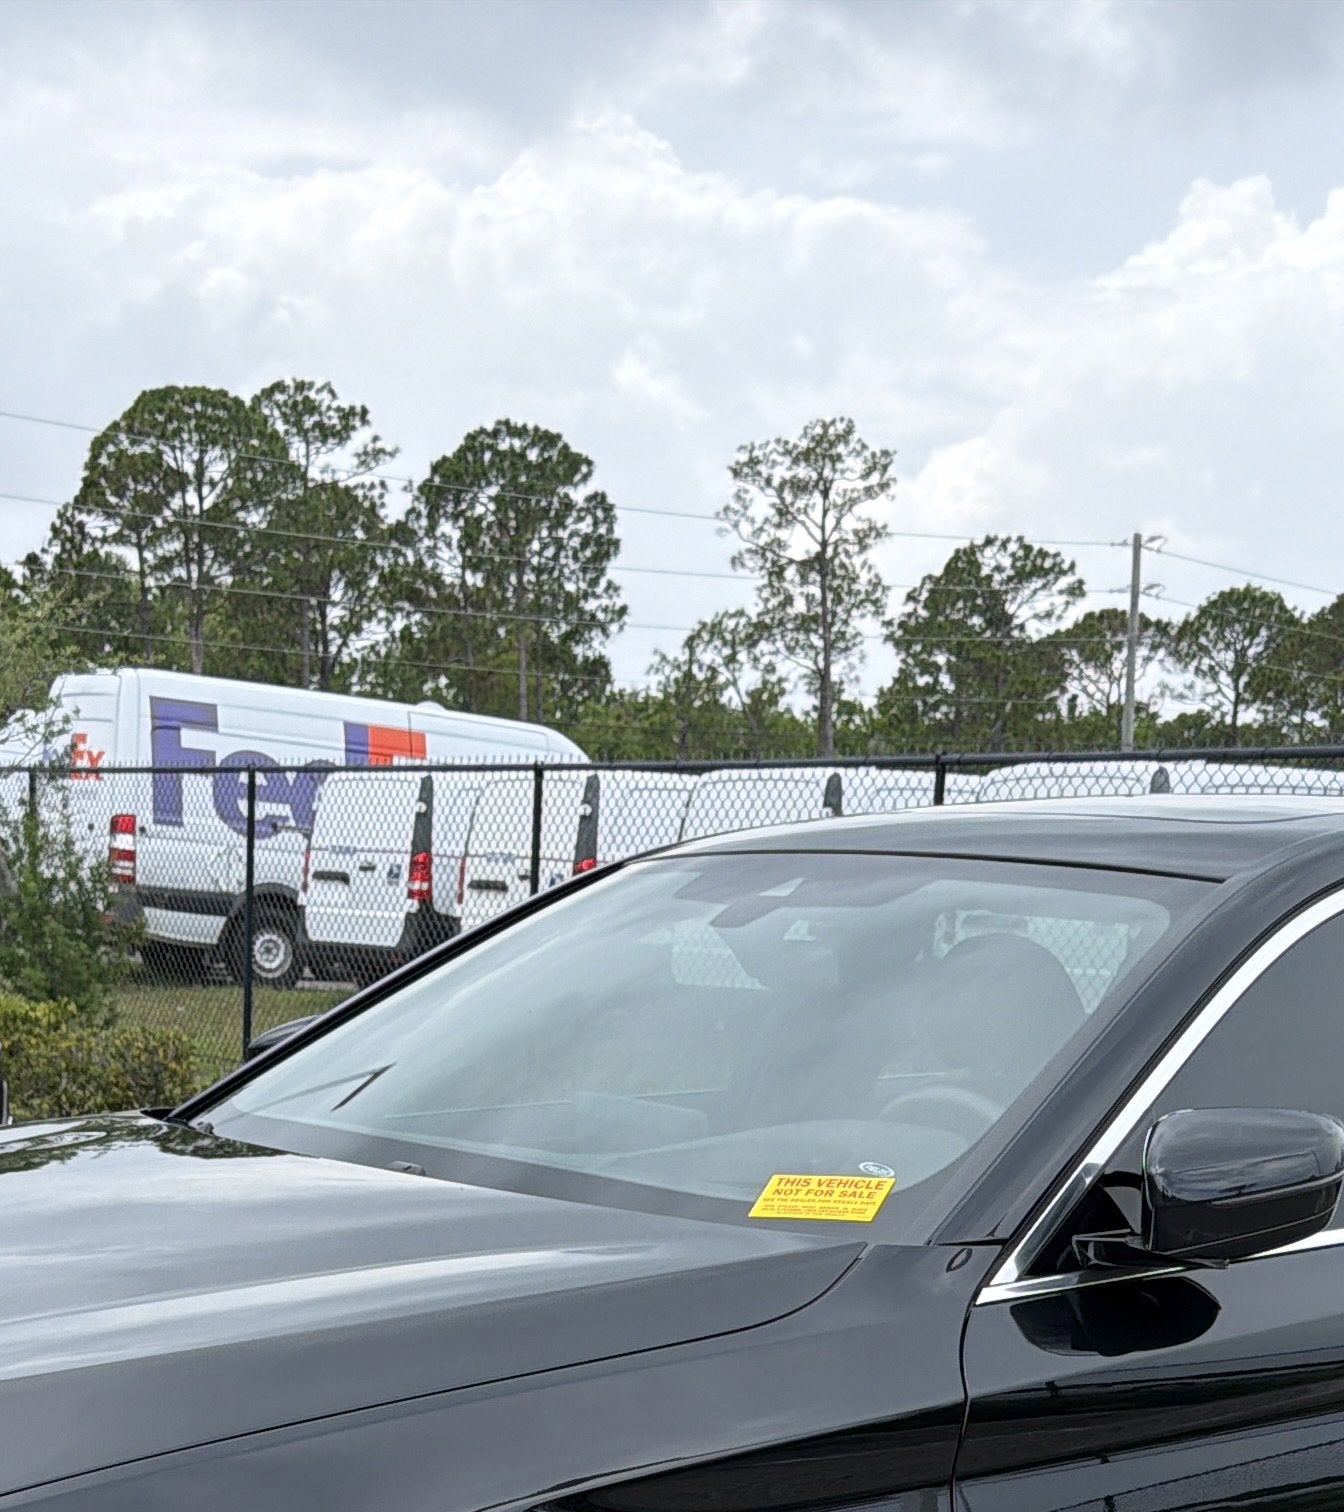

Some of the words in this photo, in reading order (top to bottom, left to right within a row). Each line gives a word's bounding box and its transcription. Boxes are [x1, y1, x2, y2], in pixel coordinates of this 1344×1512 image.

[777, 1178, 812, 1187] THIS
[817, 1178, 887, 1190] VEHICLE
[773, 1188, 803, 1196] NOT
[805, 1189, 835, 1197] FOR
[838, 1190, 877, 1199] SALE
